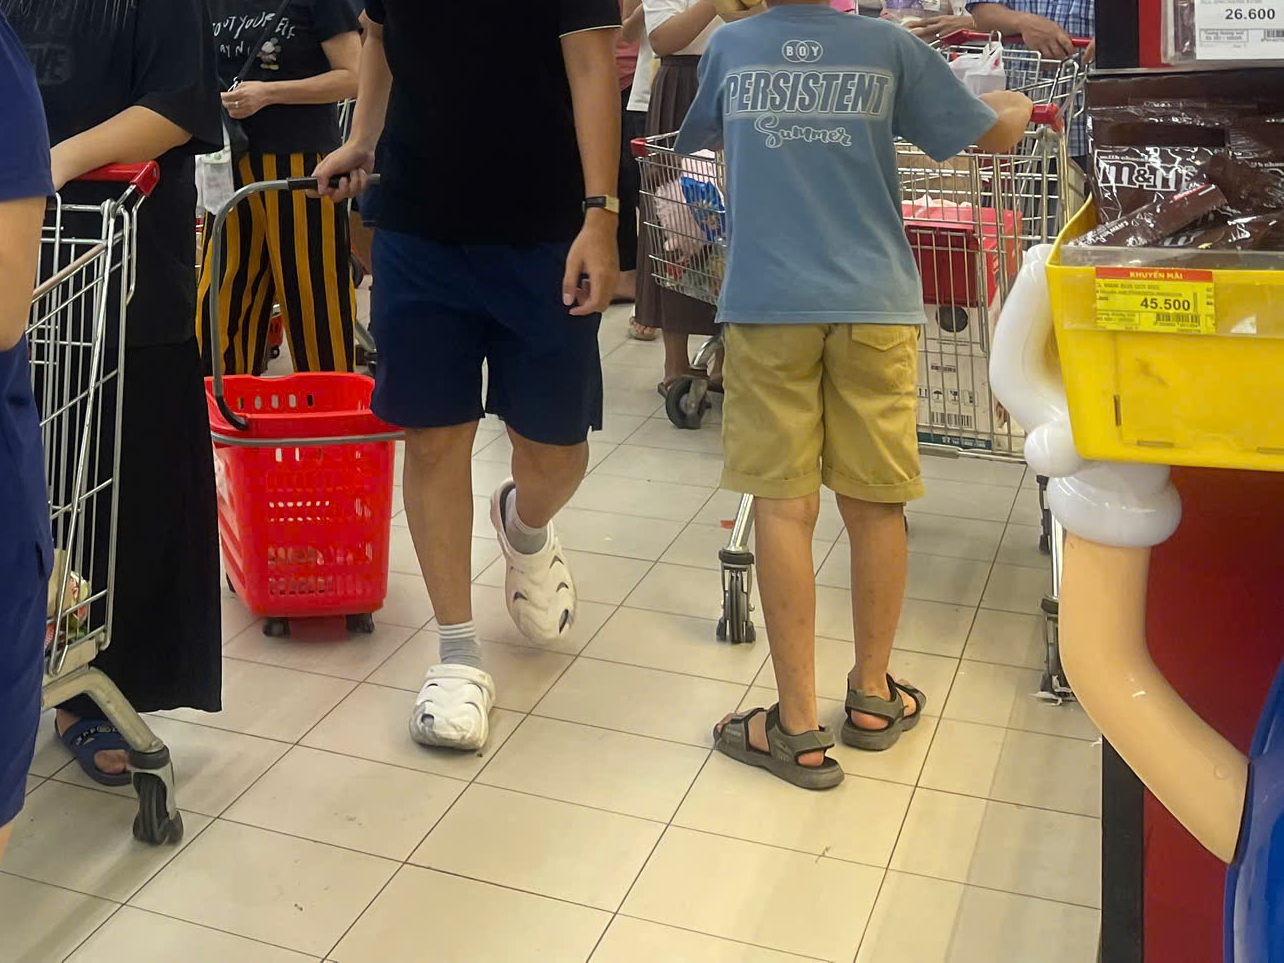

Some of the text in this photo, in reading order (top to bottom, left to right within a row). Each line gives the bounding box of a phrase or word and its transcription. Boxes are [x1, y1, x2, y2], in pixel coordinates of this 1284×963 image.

[1225, 8, 1276, 20] 26.600
[785, 45, 820, 58] BOY
[724, 71, 892, 116] PERSISTENT
[755, 114, 852, 148] Summer
[1130, 270, 1165, 279] KHUYẾN
[1140, 297, 1190, 311] 45.500
